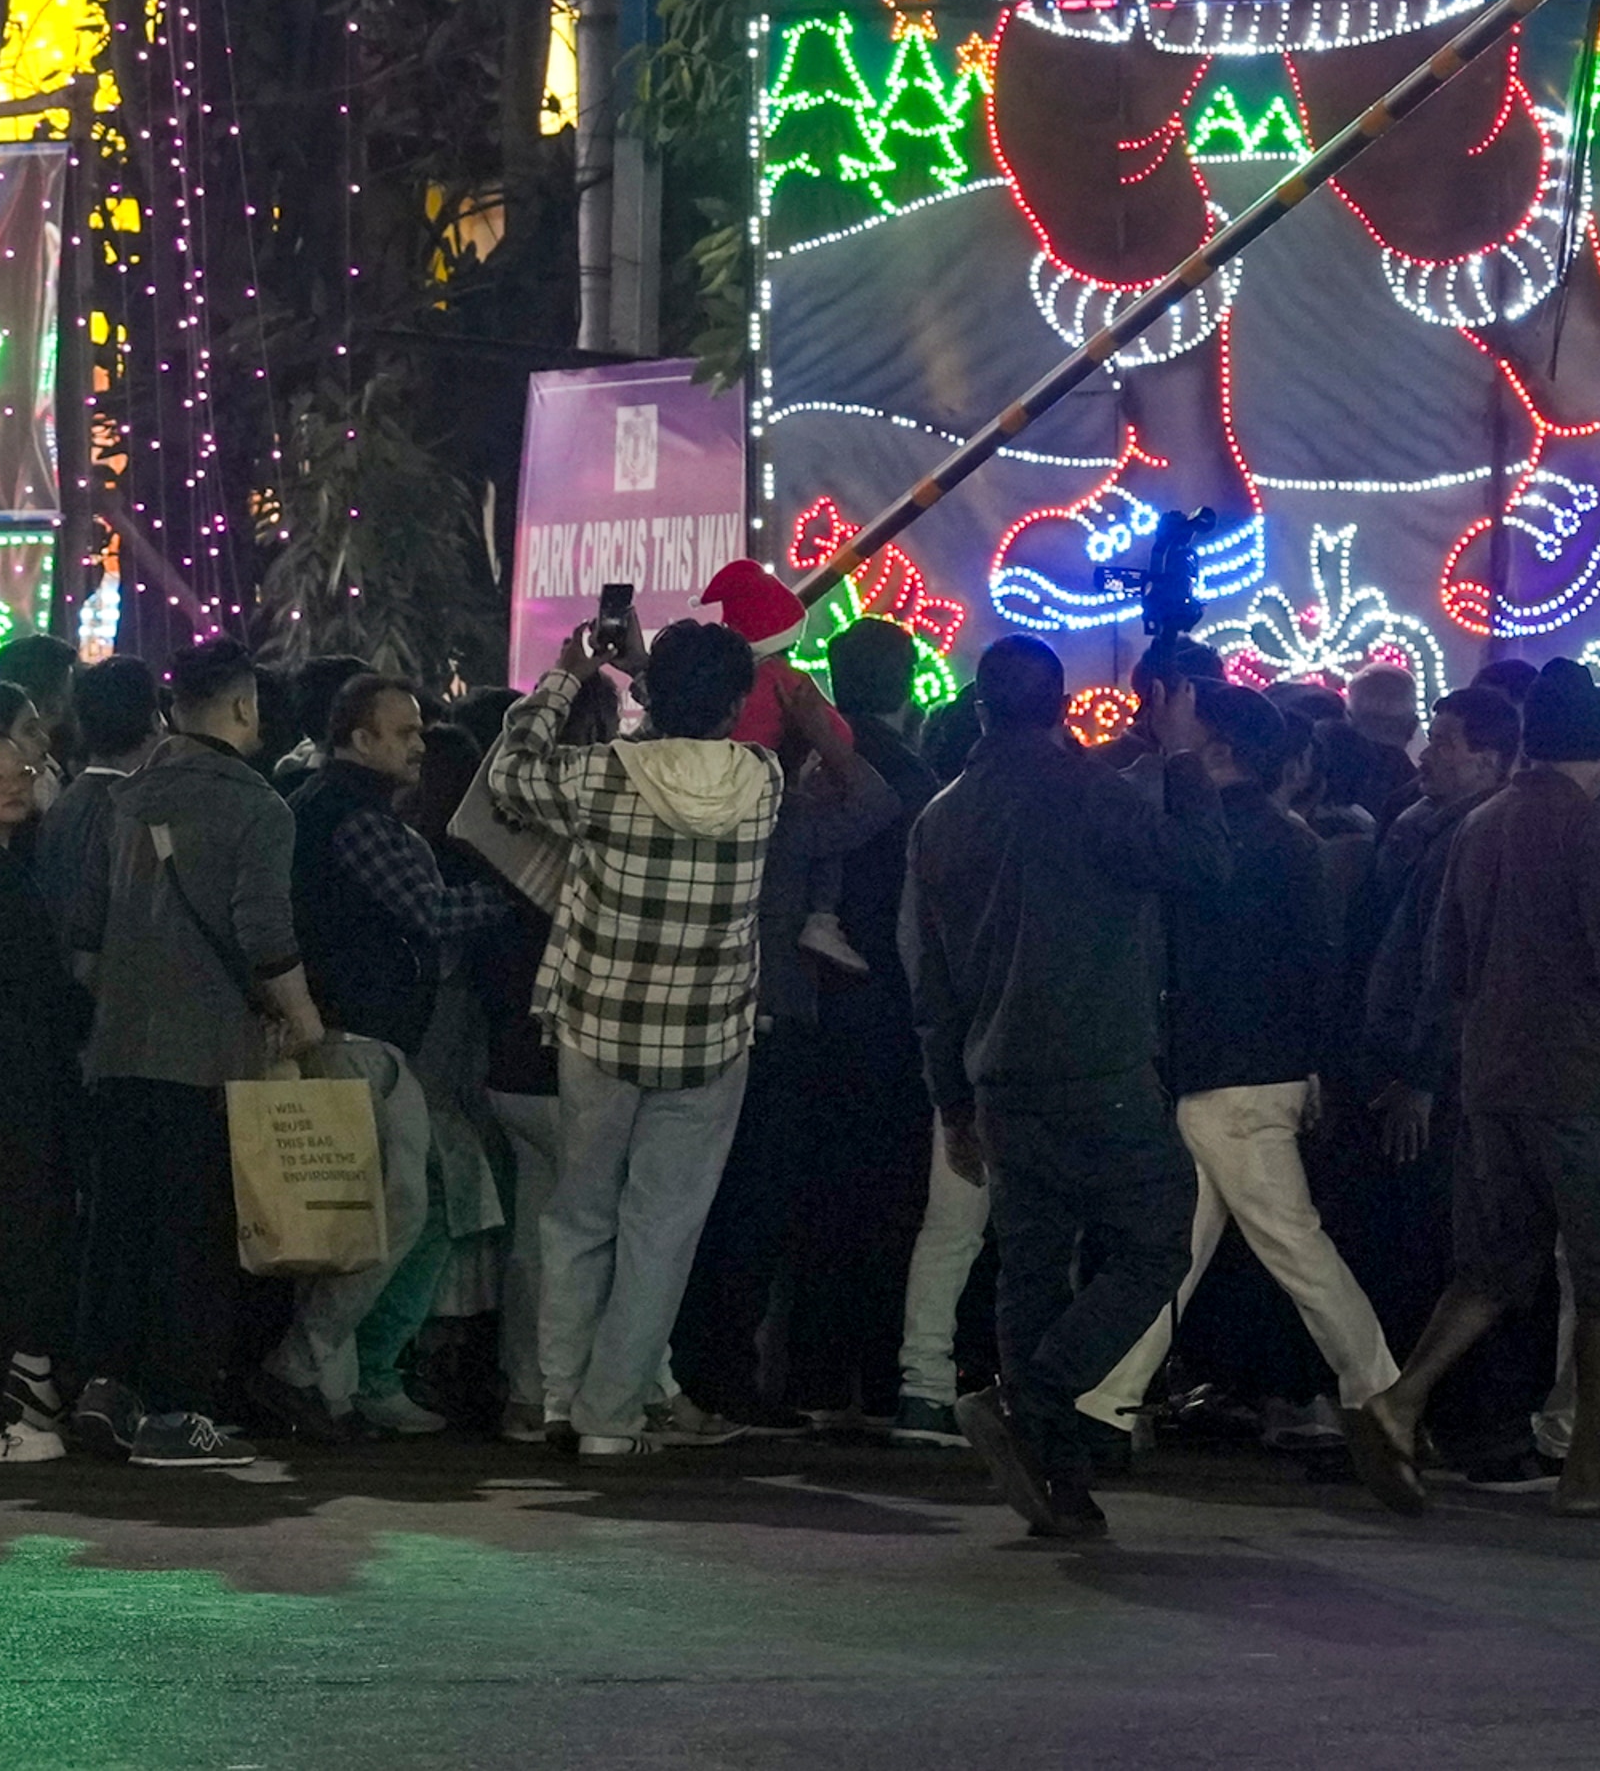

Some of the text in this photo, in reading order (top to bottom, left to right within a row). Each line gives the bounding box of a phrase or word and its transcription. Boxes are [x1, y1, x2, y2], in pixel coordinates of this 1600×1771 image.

[526, 512, 739, 599] PARK CIRCUS THIS WAY
[276, 1137, 304, 1150] THIS
[280, 1155, 296, 1166] TO
[299, 1152, 333, 1166] SAVE
[283, 1170, 368, 1184] ENVIRONMENT
